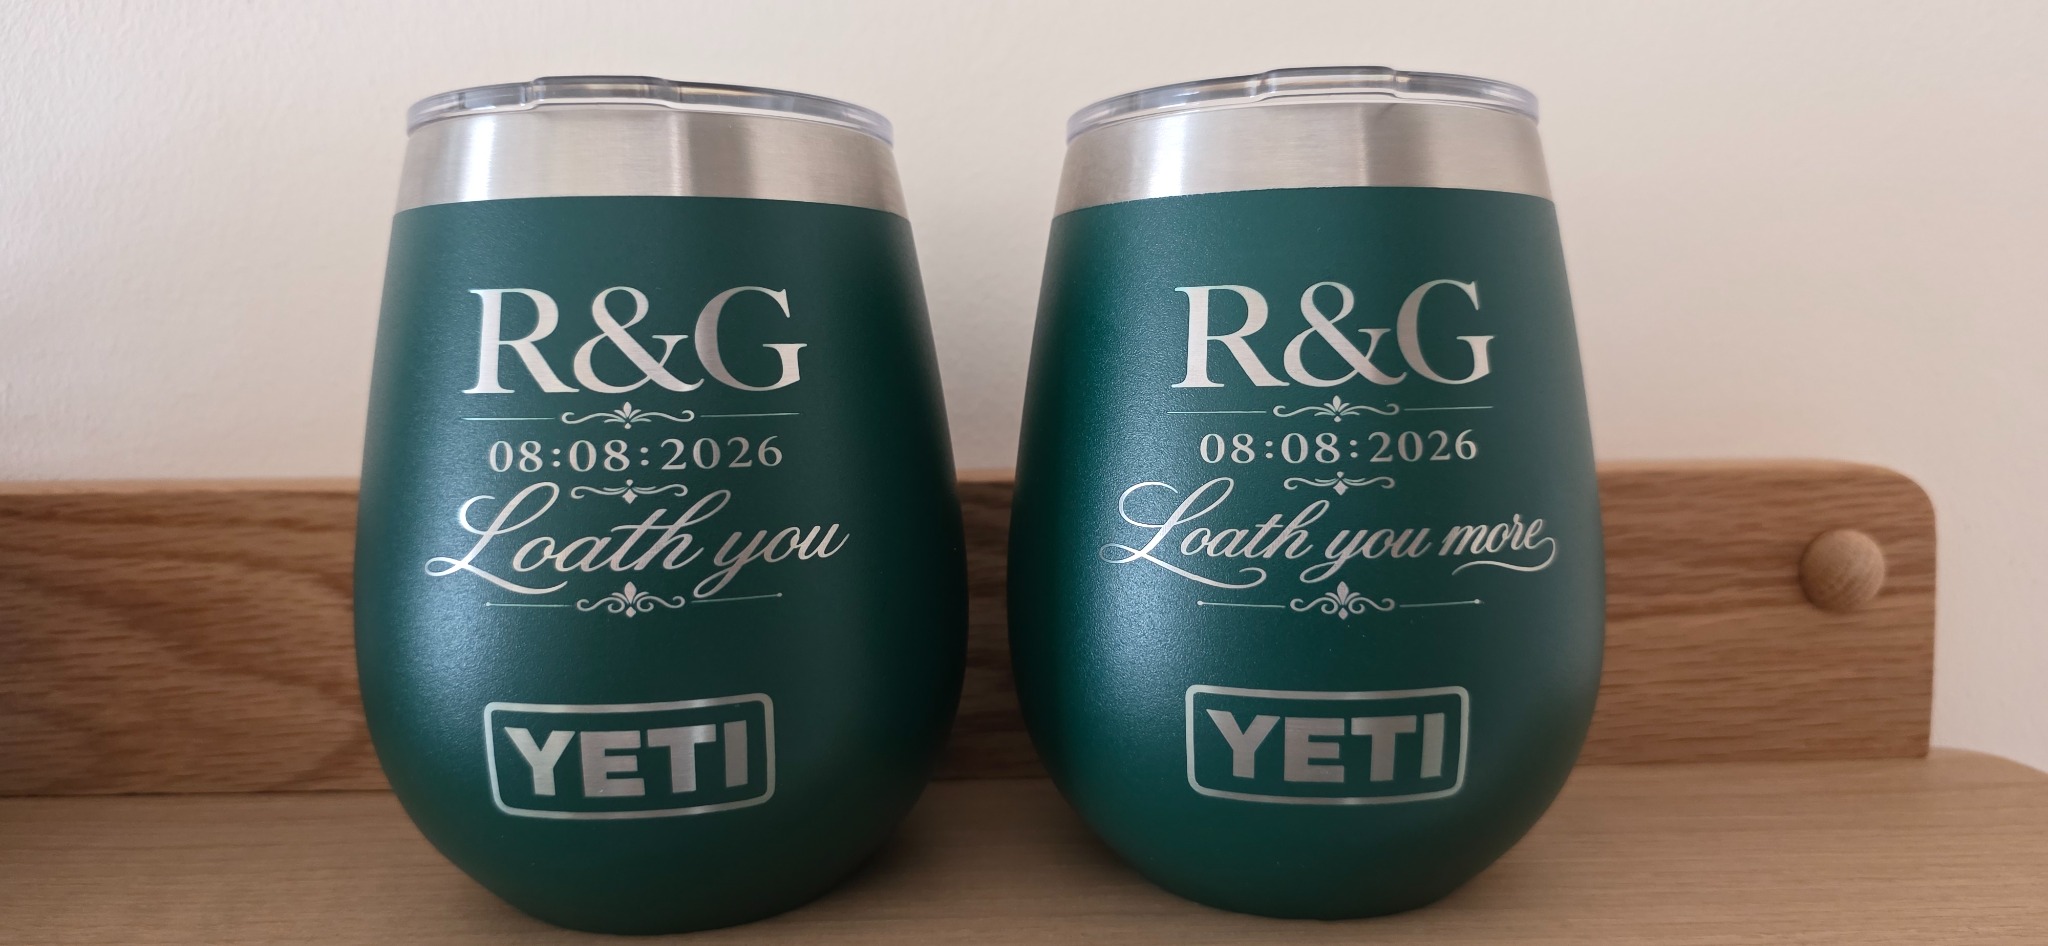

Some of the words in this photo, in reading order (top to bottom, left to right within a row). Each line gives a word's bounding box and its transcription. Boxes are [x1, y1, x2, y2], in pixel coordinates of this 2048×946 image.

[462, 286, 807, 394] R&G
[1171, 279, 1495, 388] R&G
[489, 436, 783, 472] 08:08:2026
[1200, 429, 1478, 463] 08:08:2026
[424, 481, 732, 595] Loath
[693, 523, 850, 598] you
[1101, 477, 1330, 589] Loath
[1300, 523, 1433, 583] you
[1438, 512, 1556, 575] more
[504, 720, 748, 797] YETI
[1206, 708, 1445, 783] YETI
